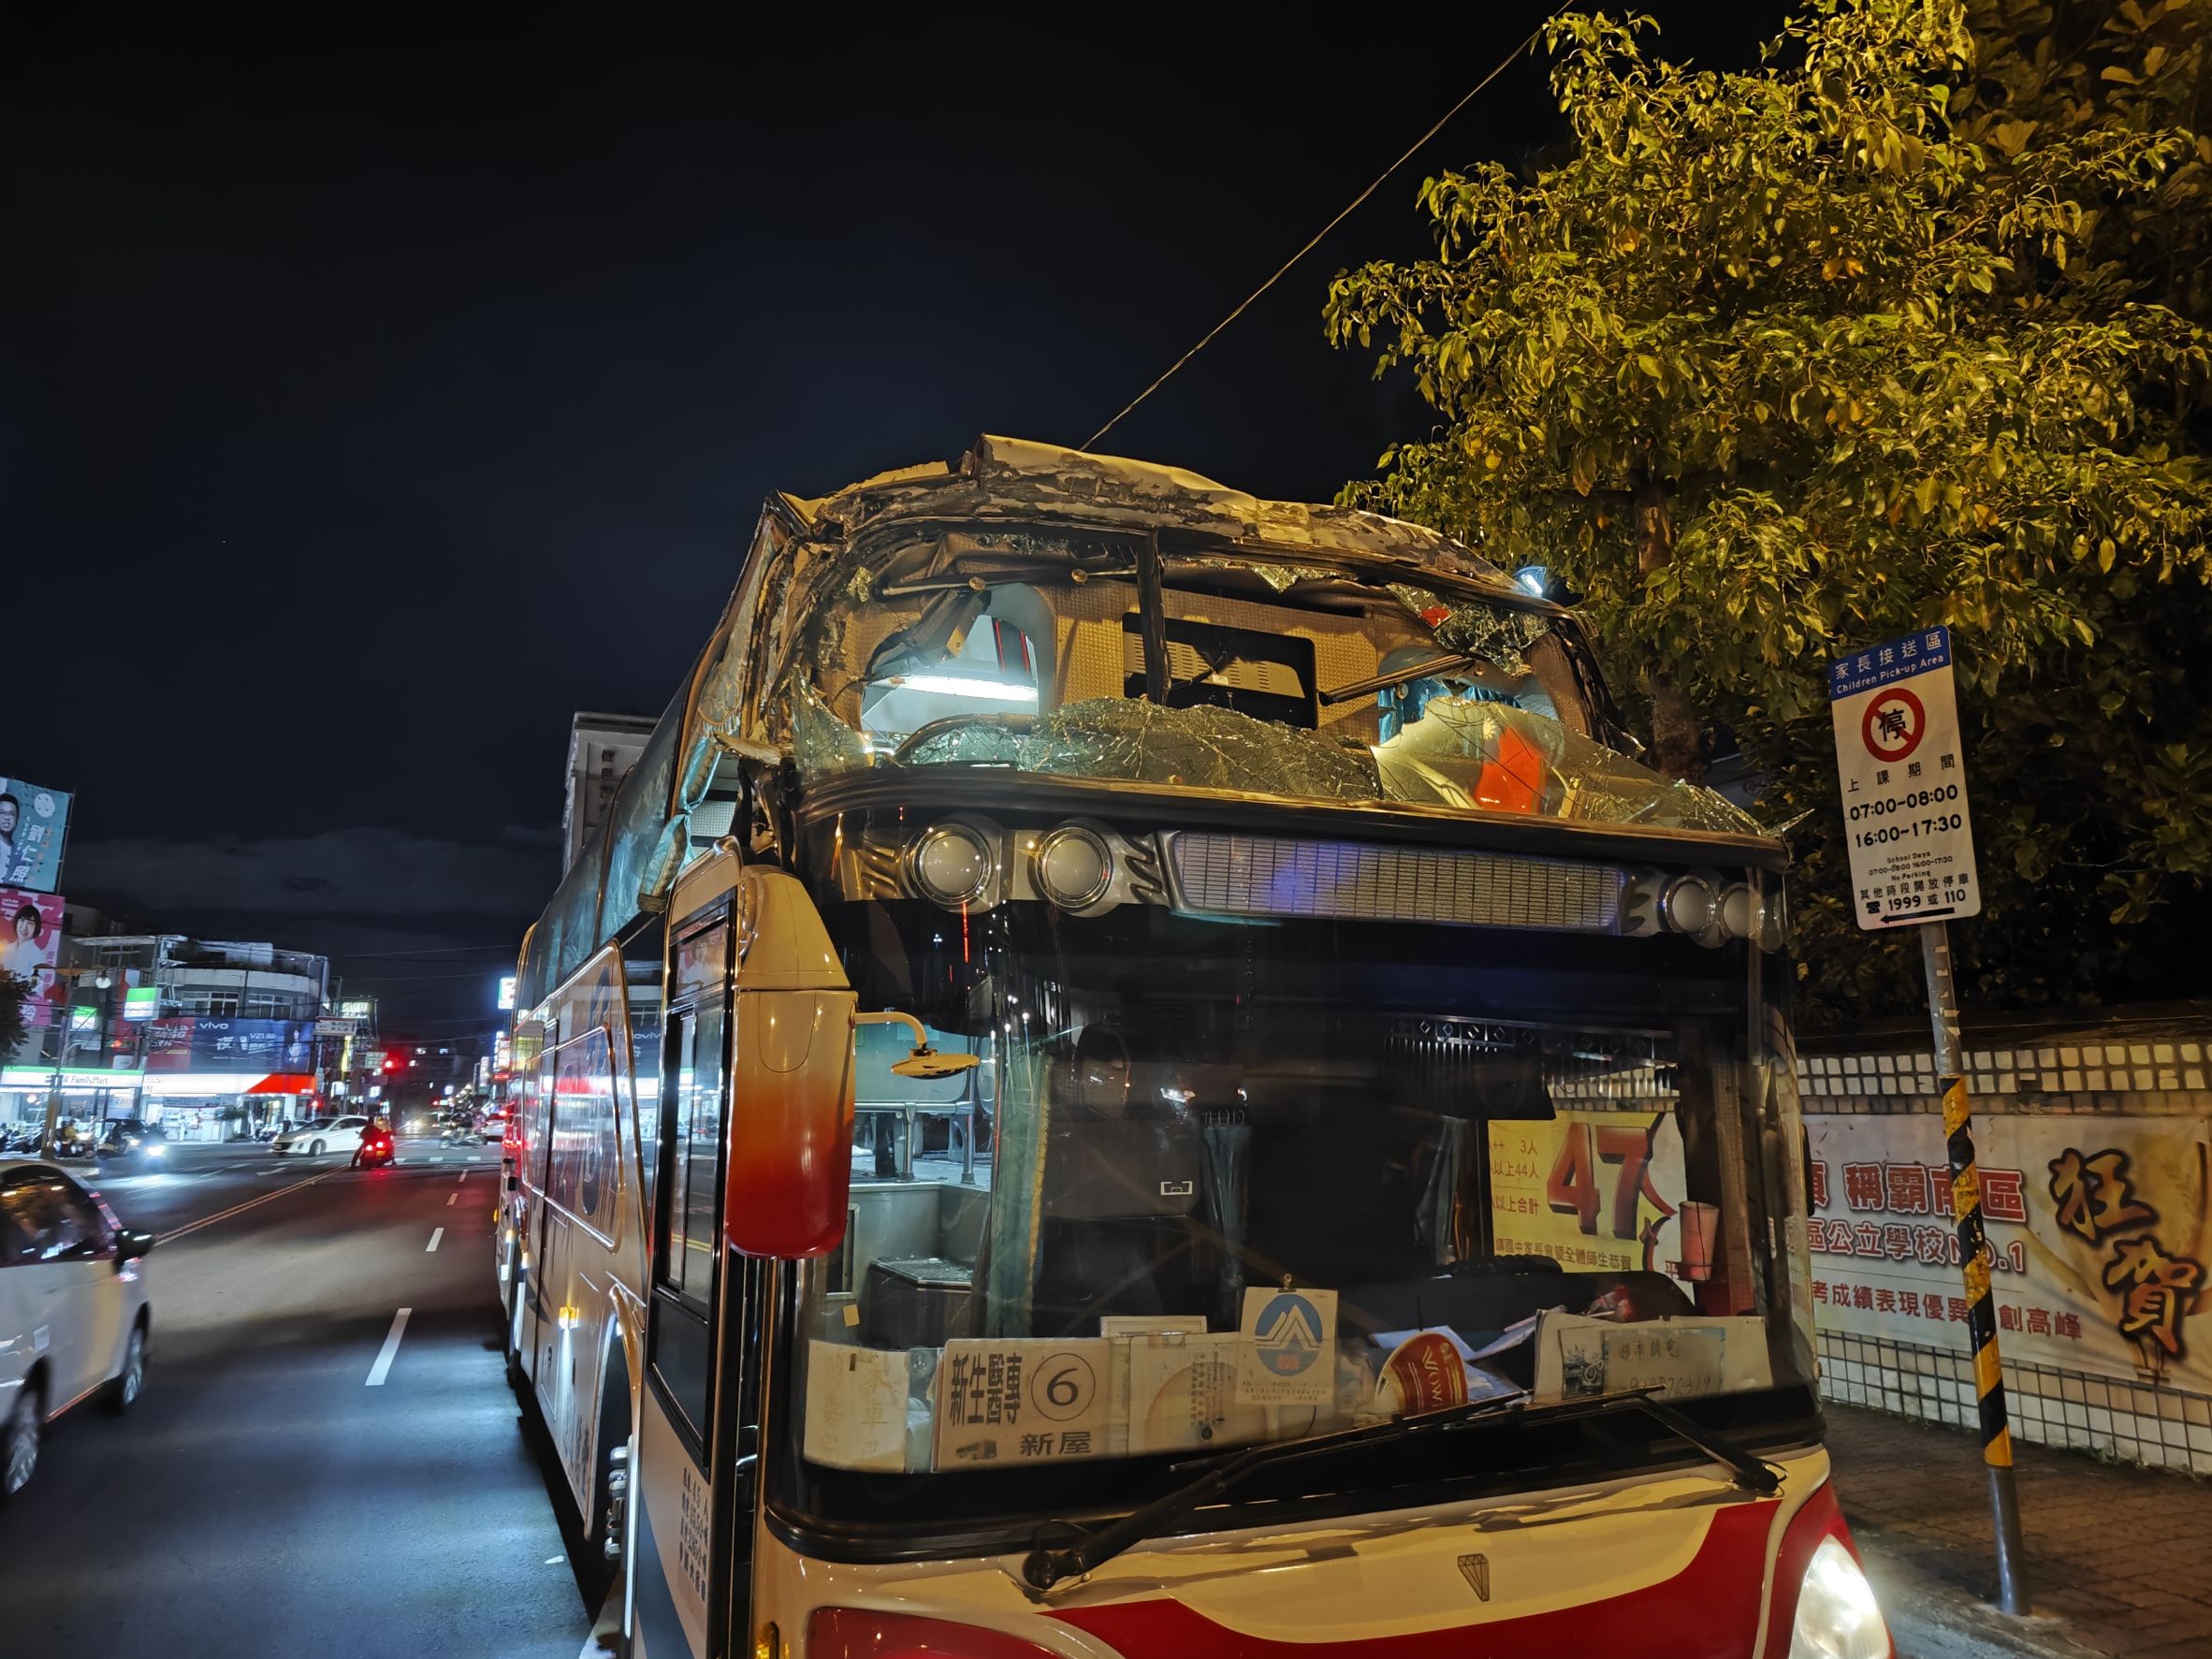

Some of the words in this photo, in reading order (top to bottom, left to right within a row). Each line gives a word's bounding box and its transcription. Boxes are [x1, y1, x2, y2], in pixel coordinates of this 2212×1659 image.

[1835, 631, 1943, 680] 家長接送區
[1836, 675, 1877, 693] Children
[1880, 662, 1917, 680] Pick-up
[1919, 654, 1944, 668] Area
[1878, 707, 1907, 742] 停
[1847, 753, 1956, 793] 上課期間
[1886, 854, 1910, 864] School
[1912, 851, 1930, 860] Days
[1860, 873, 1970, 900] 其他時段開放停車
[1901, 870, 1931, 880] Parking
[1888, 895, 1921, 911] 1999
[1927, 894, 1939, 905] 或
[1944, 889, 1966, 904] 110
[199, 1021, 229, 1029] vivo
[1520, 1139, 1538, 1155] 3人
[1491, 1160, 1539, 1179] 以上44人
[1547, 1122, 1649, 1241] 47
[1492, 1195, 1539, 1215] 以上合計
[2048, 1147, 2205, 1355] 狂賀
[950, 1352, 1023, 1427] 新生醫專
[1020, 1431, 1092, 1456] 新屋
